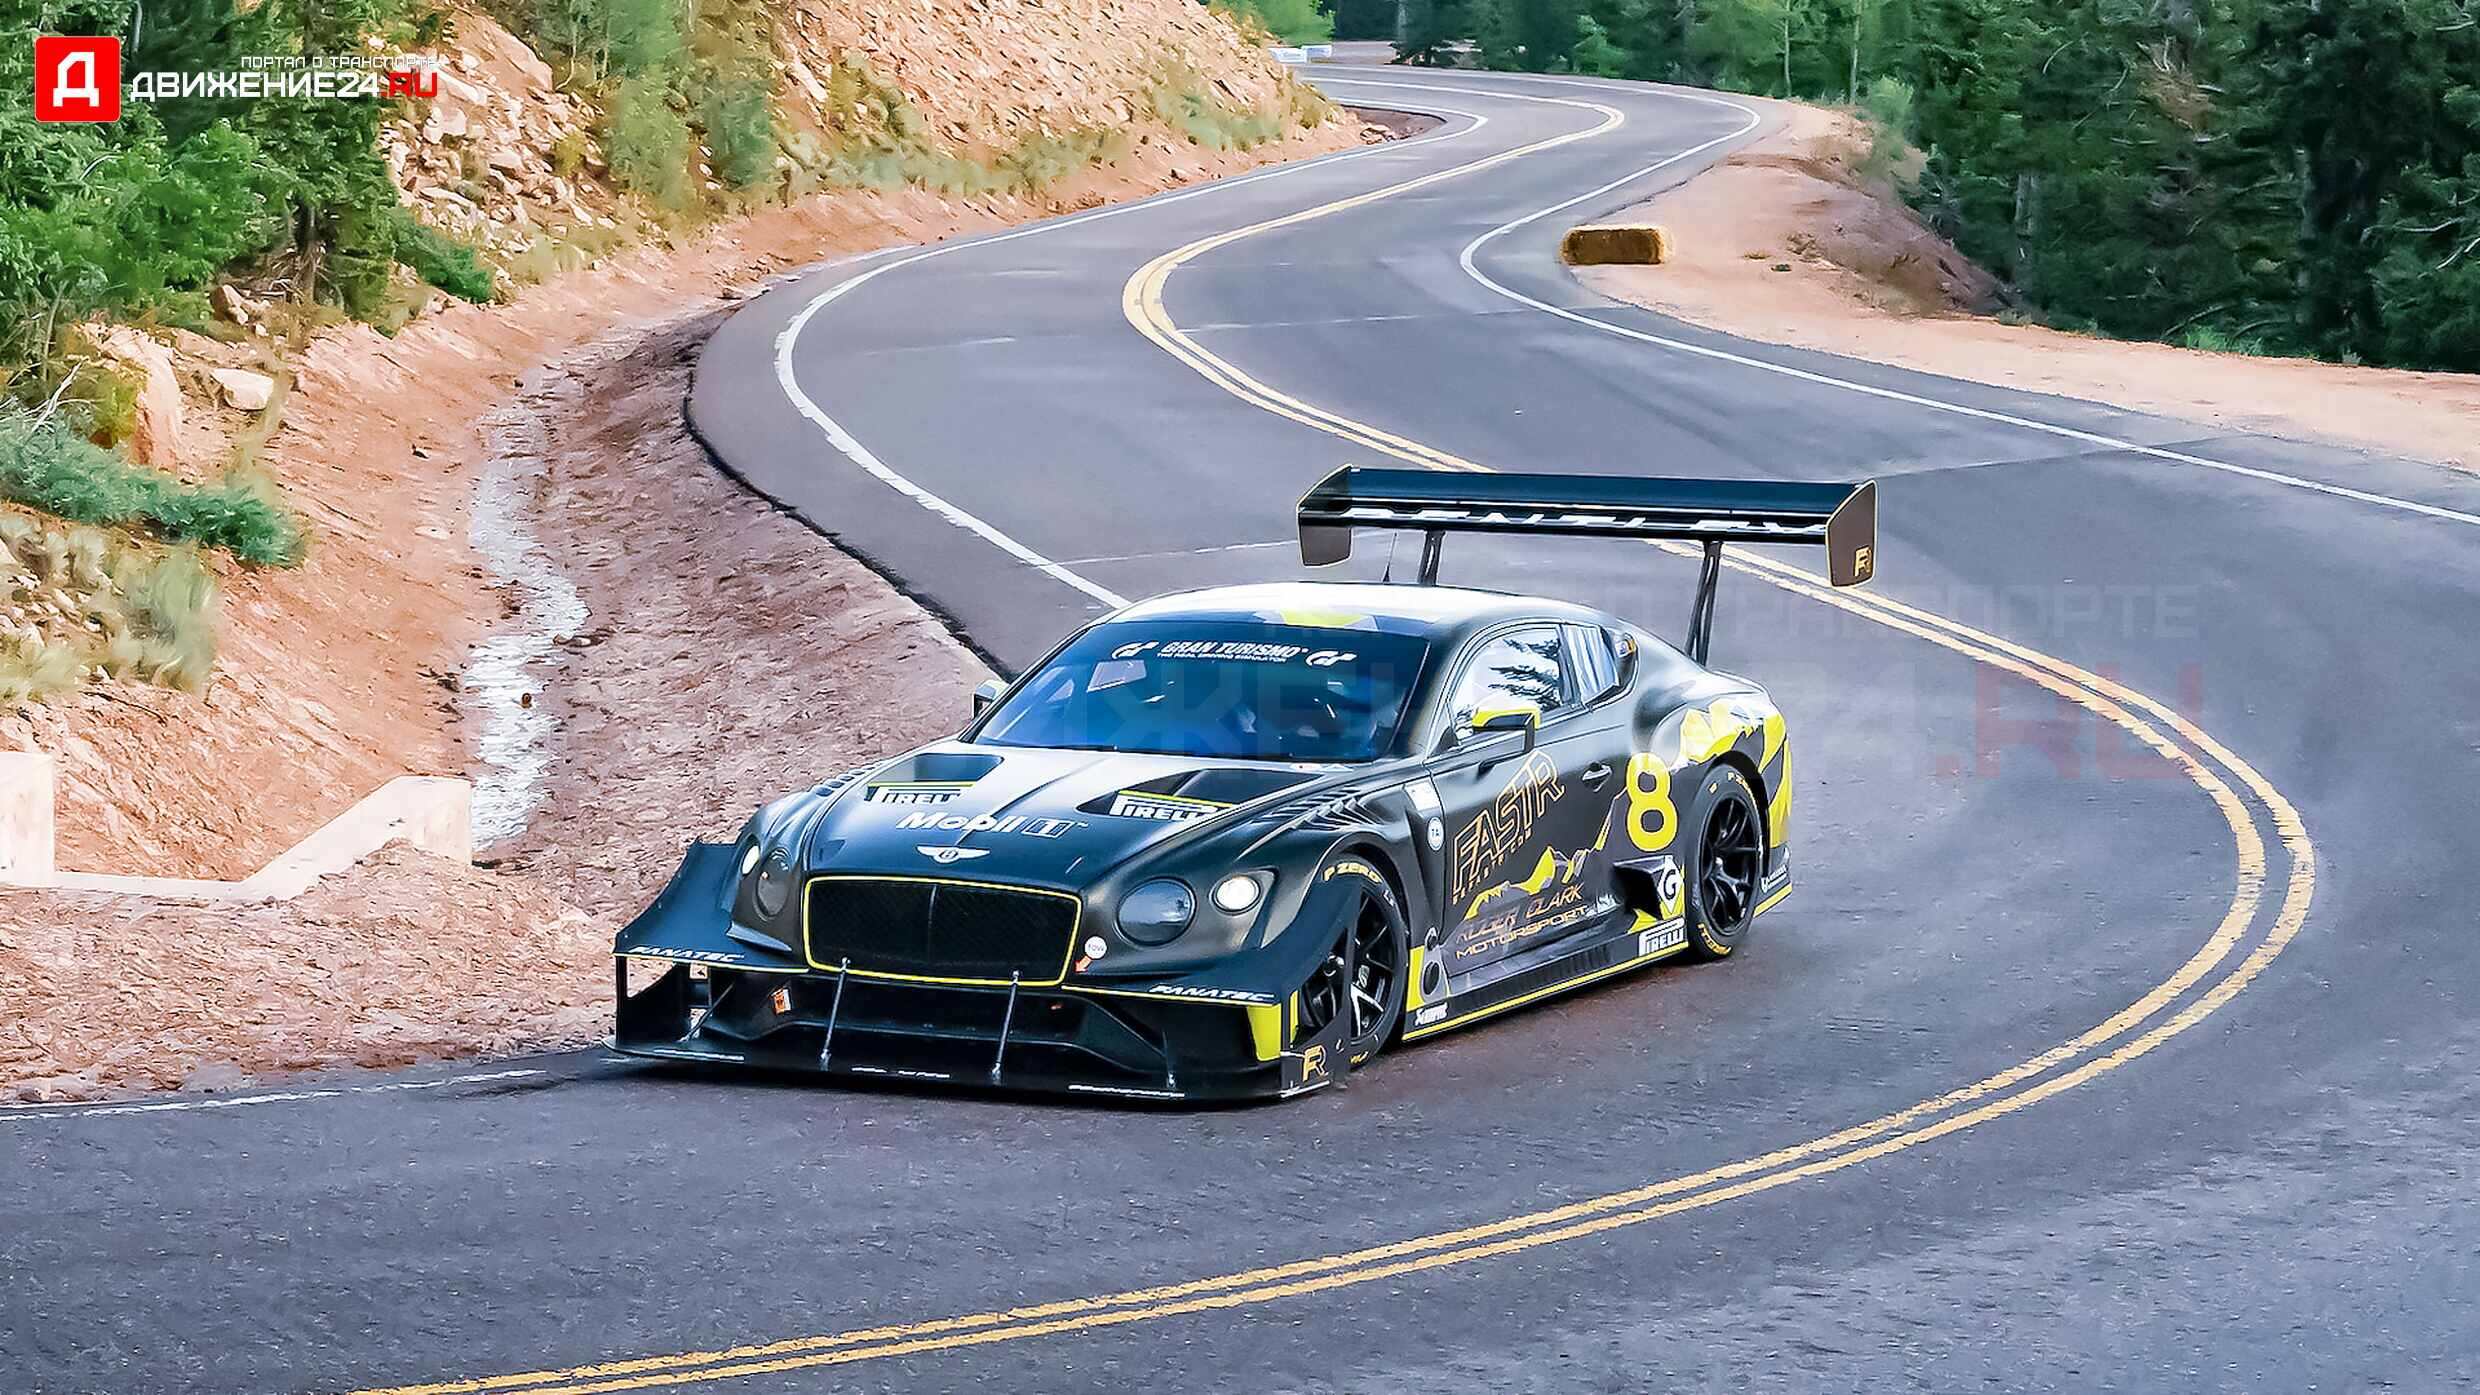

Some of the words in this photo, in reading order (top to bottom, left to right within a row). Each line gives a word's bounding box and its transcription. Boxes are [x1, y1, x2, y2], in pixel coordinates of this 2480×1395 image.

[1161, 641, 1219, 654] GRAN
[1215, 642, 1301, 659] TURISMO
[1626, 752, 1678, 851] 8
[896, 812, 1026, 833] Mobil
[1456, 905, 1588, 959] MOTORSPORT
[1639, 917, 1685, 956] PIRELLI
[627, 946, 745, 962] FANATEC
[1149, 985, 1275, 1001] FANATEC
